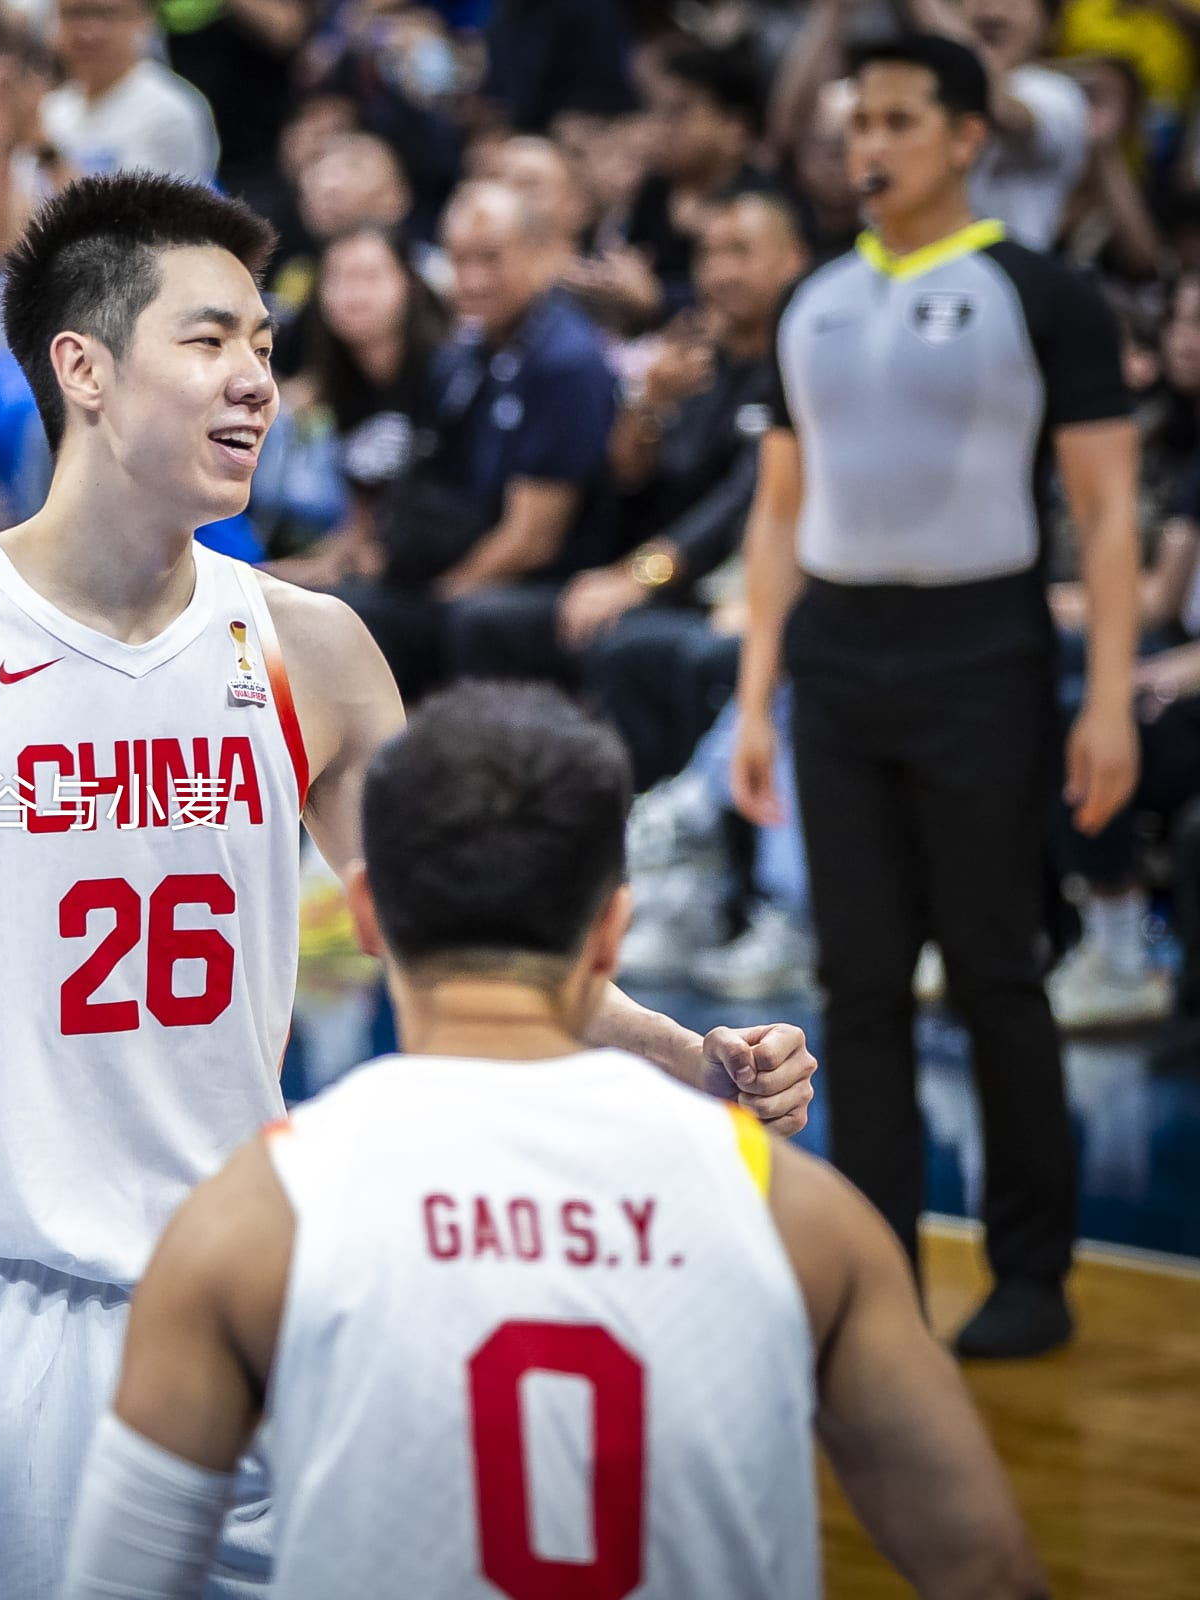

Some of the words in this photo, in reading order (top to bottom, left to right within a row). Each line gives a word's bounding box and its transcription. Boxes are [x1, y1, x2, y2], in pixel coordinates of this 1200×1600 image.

[17, 736, 264, 834] CHINA
[58, 873, 237, 1036] 26
[421, 1192, 544, 1264] GAO
[559, 1195, 686, 1269] S.Y.
[465, 1318, 648, 1600] 0
